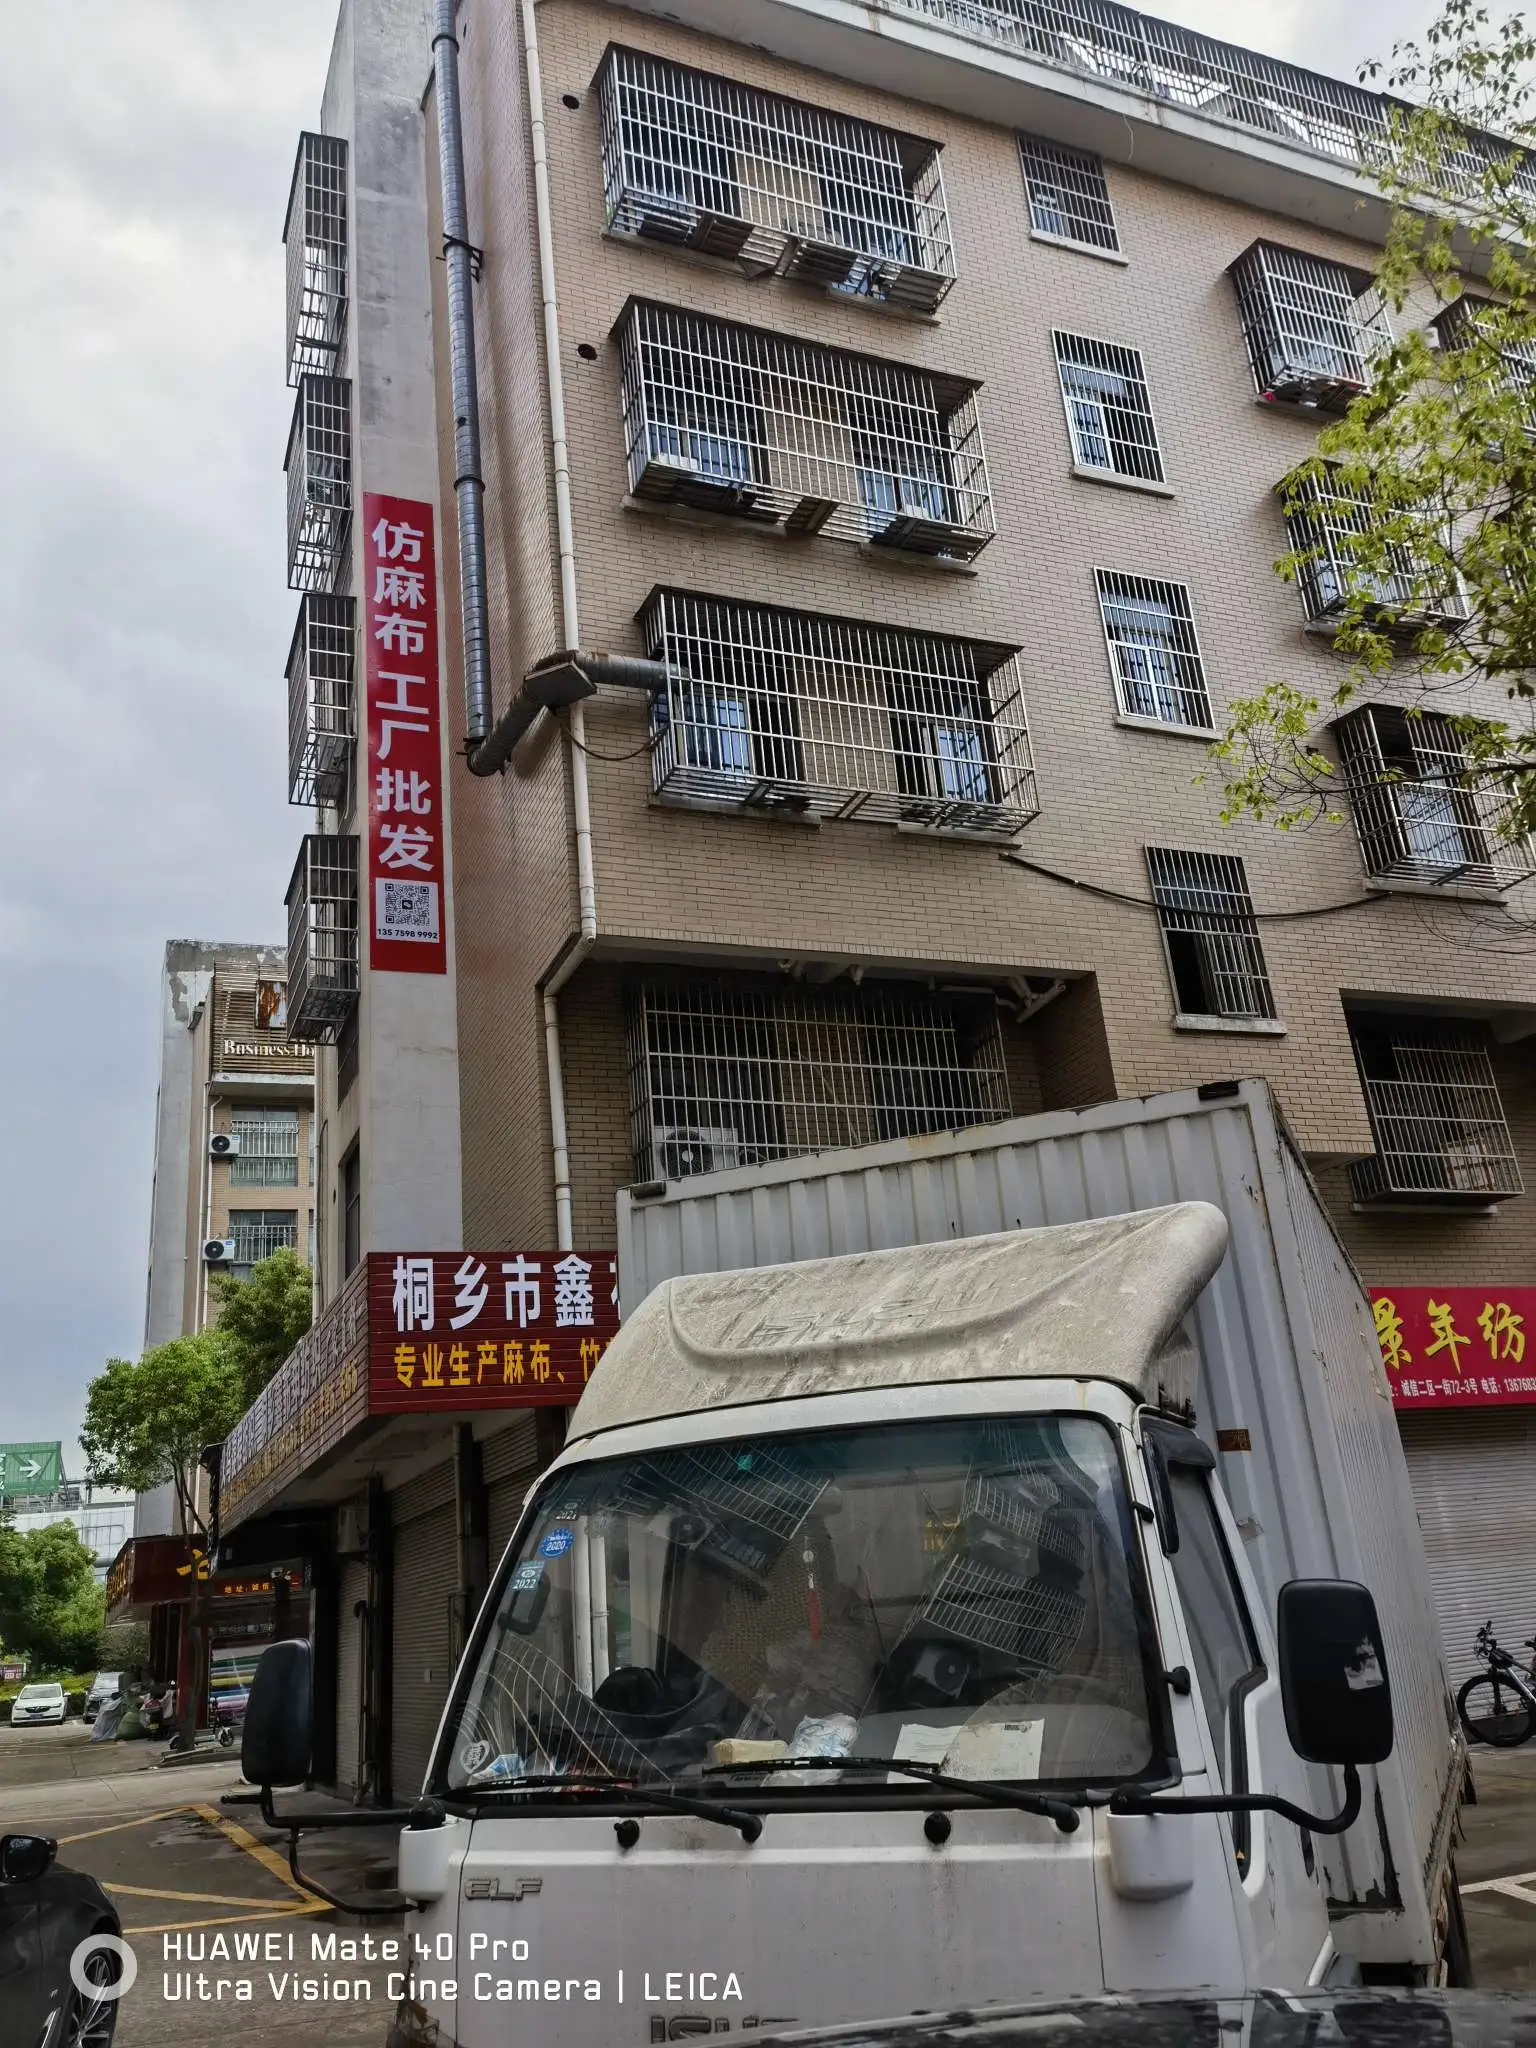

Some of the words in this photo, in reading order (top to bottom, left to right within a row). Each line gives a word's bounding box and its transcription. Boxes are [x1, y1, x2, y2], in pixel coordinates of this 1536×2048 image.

[372, 518, 434, 872] 仿麻布工厂批发
[377, 928, 393, 936] 135
[395, 929, 416, 937] 7598
[417, 931, 438, 939] 9992
[223, 1039, 290, 1056] Business
[392, 1254, 621, 1332] 桐乡市鑫
[394, 1337, 615, 1389] 专业生产麻布、竹
[512, 1579, 537, 1590] 2022
[465, 1878, 542, 1902] ELF
